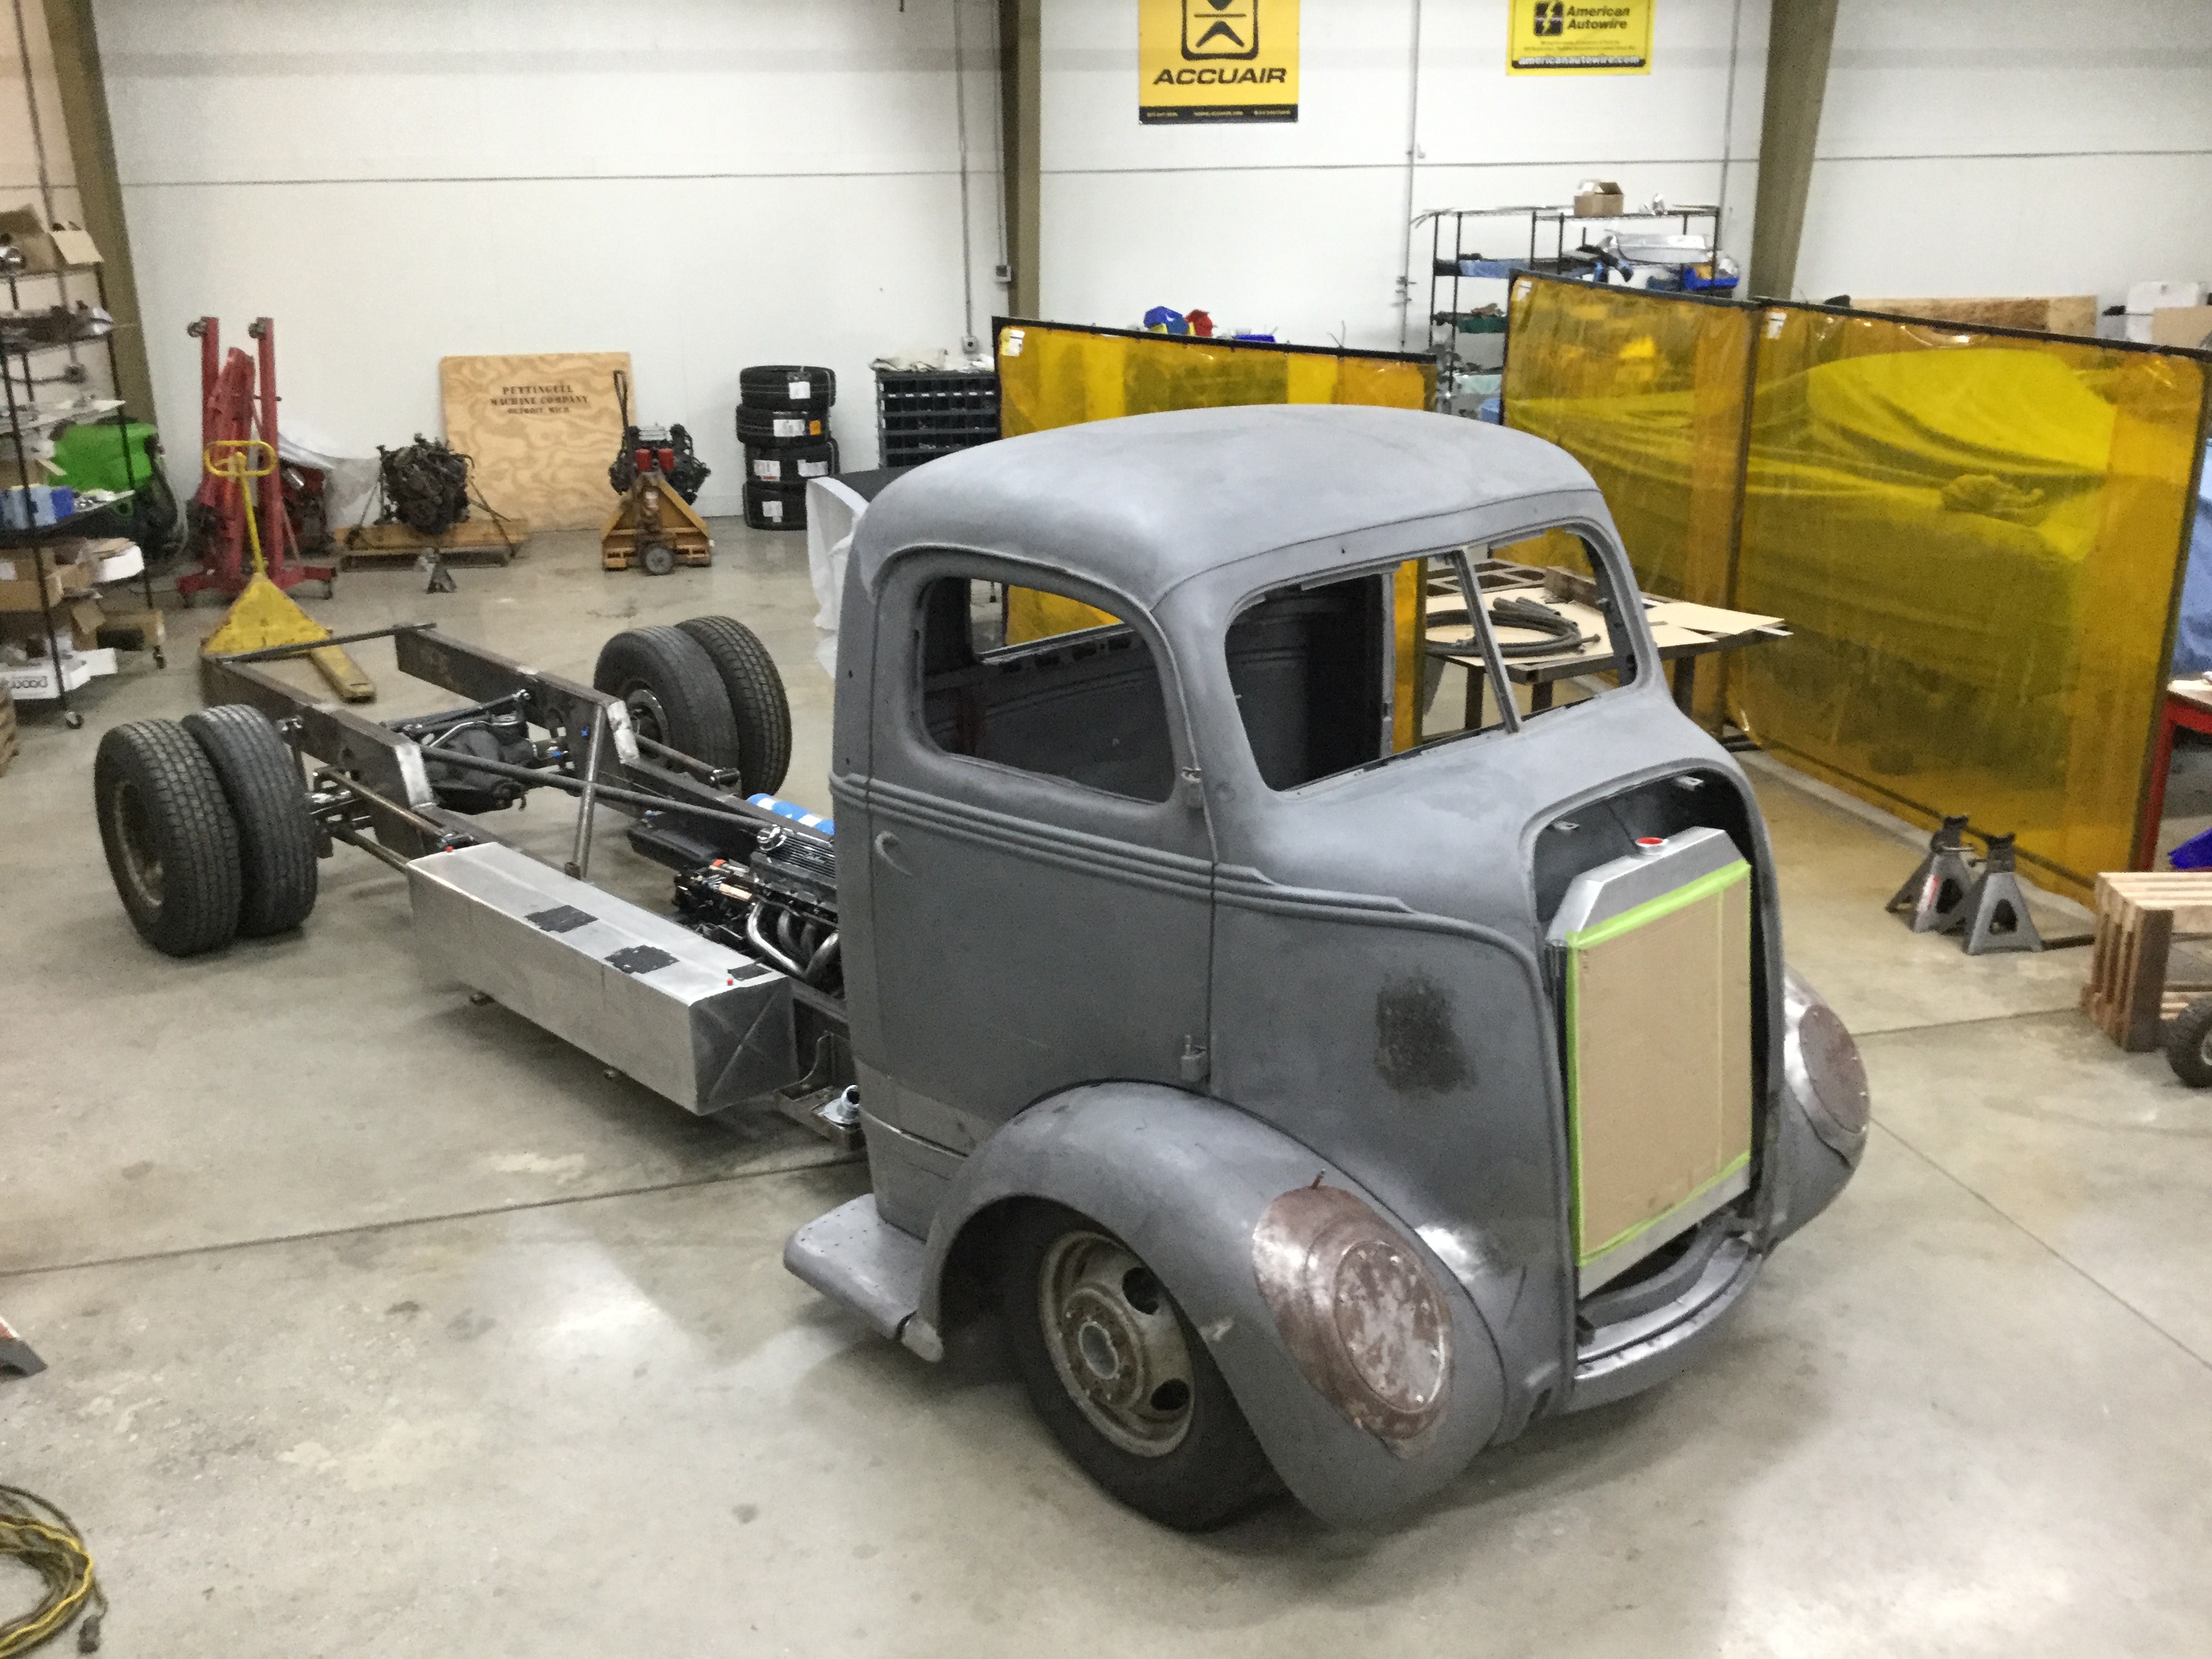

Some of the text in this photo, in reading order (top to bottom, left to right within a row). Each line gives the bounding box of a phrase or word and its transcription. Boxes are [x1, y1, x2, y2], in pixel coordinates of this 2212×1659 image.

[1566, 5, 1630, 16] American
[1567, 18, 1628, 29] Autowire
[1152, 67, 1287, 85] ACCUAIR
[490, 395, 588, 405] MACHINE COMPANY
